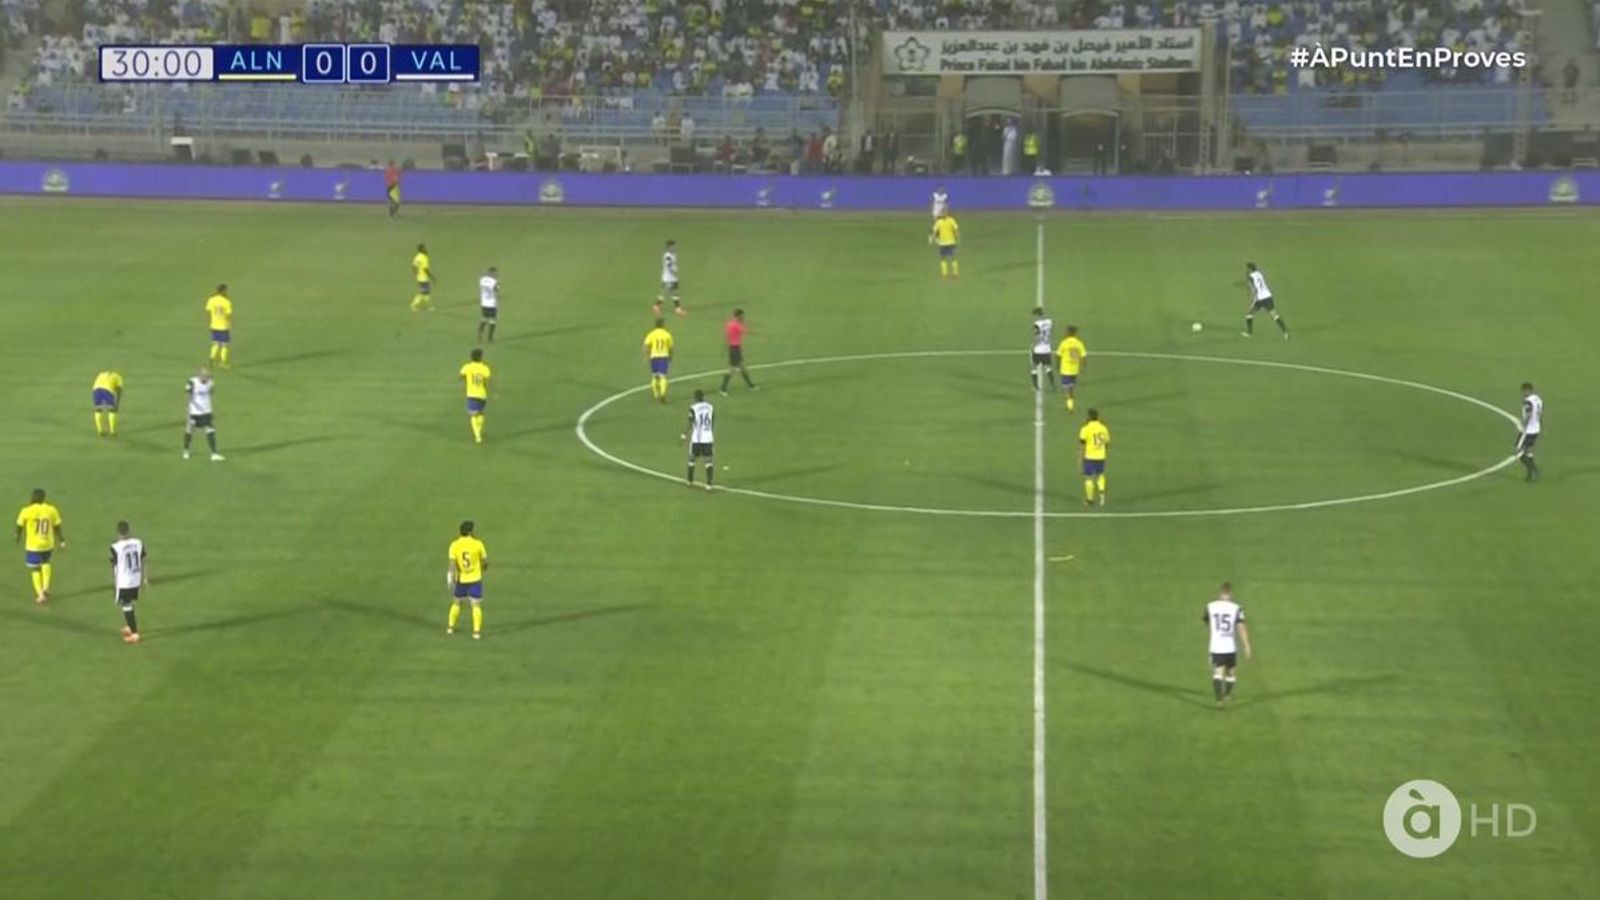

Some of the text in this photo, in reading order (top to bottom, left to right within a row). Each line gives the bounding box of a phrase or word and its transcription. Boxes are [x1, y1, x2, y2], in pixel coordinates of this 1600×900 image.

[941, 58, 975, 70] Prince
[1147, 56, 1193, 69] Stadium
[461, 551, 471, 569] 5
[1213, 613, 1231, 632] 15
